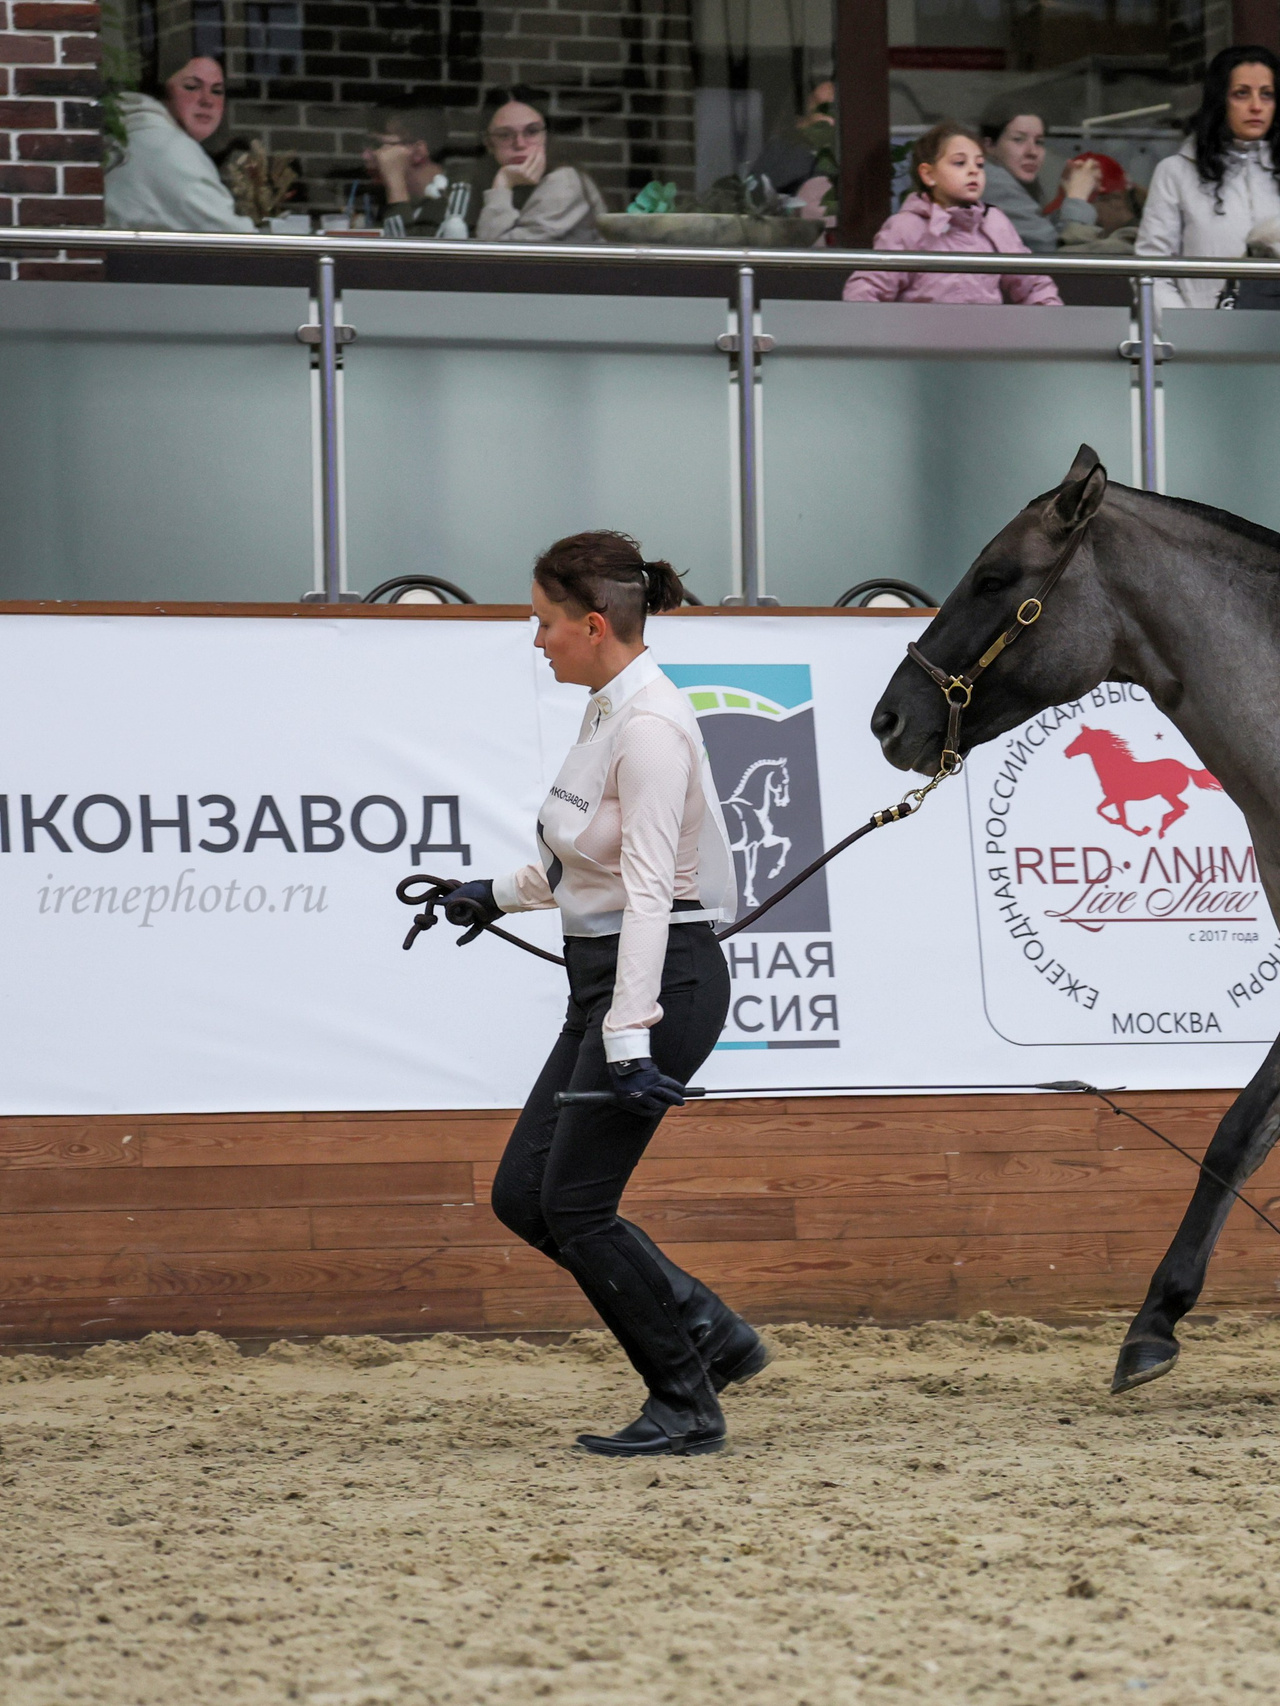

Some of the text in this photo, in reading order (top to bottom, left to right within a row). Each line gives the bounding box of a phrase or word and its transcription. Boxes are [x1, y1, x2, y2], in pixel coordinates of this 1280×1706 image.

[1091, 683, 1145, 708] ВЫС
[985, 700, 1085, 854] РОССИЙСКАЯ
[0, 794, 472, 866] КОНЗАВОД
[1140, 846, 1257, 884] ANIM
[1044, 866, 1259, 933] Live Show
[988, 866, 1100, 1010] ЕЖЕГОДНАЯ
[1199, 930, 1228, 942] 2017
[1231, 932, 1259, 944] года
[729, 941, 836, 979] НАЯ
[731, 994, 840, 1033] СИЯ
[1112, 1012, 1222, 1035] МОСКВА
